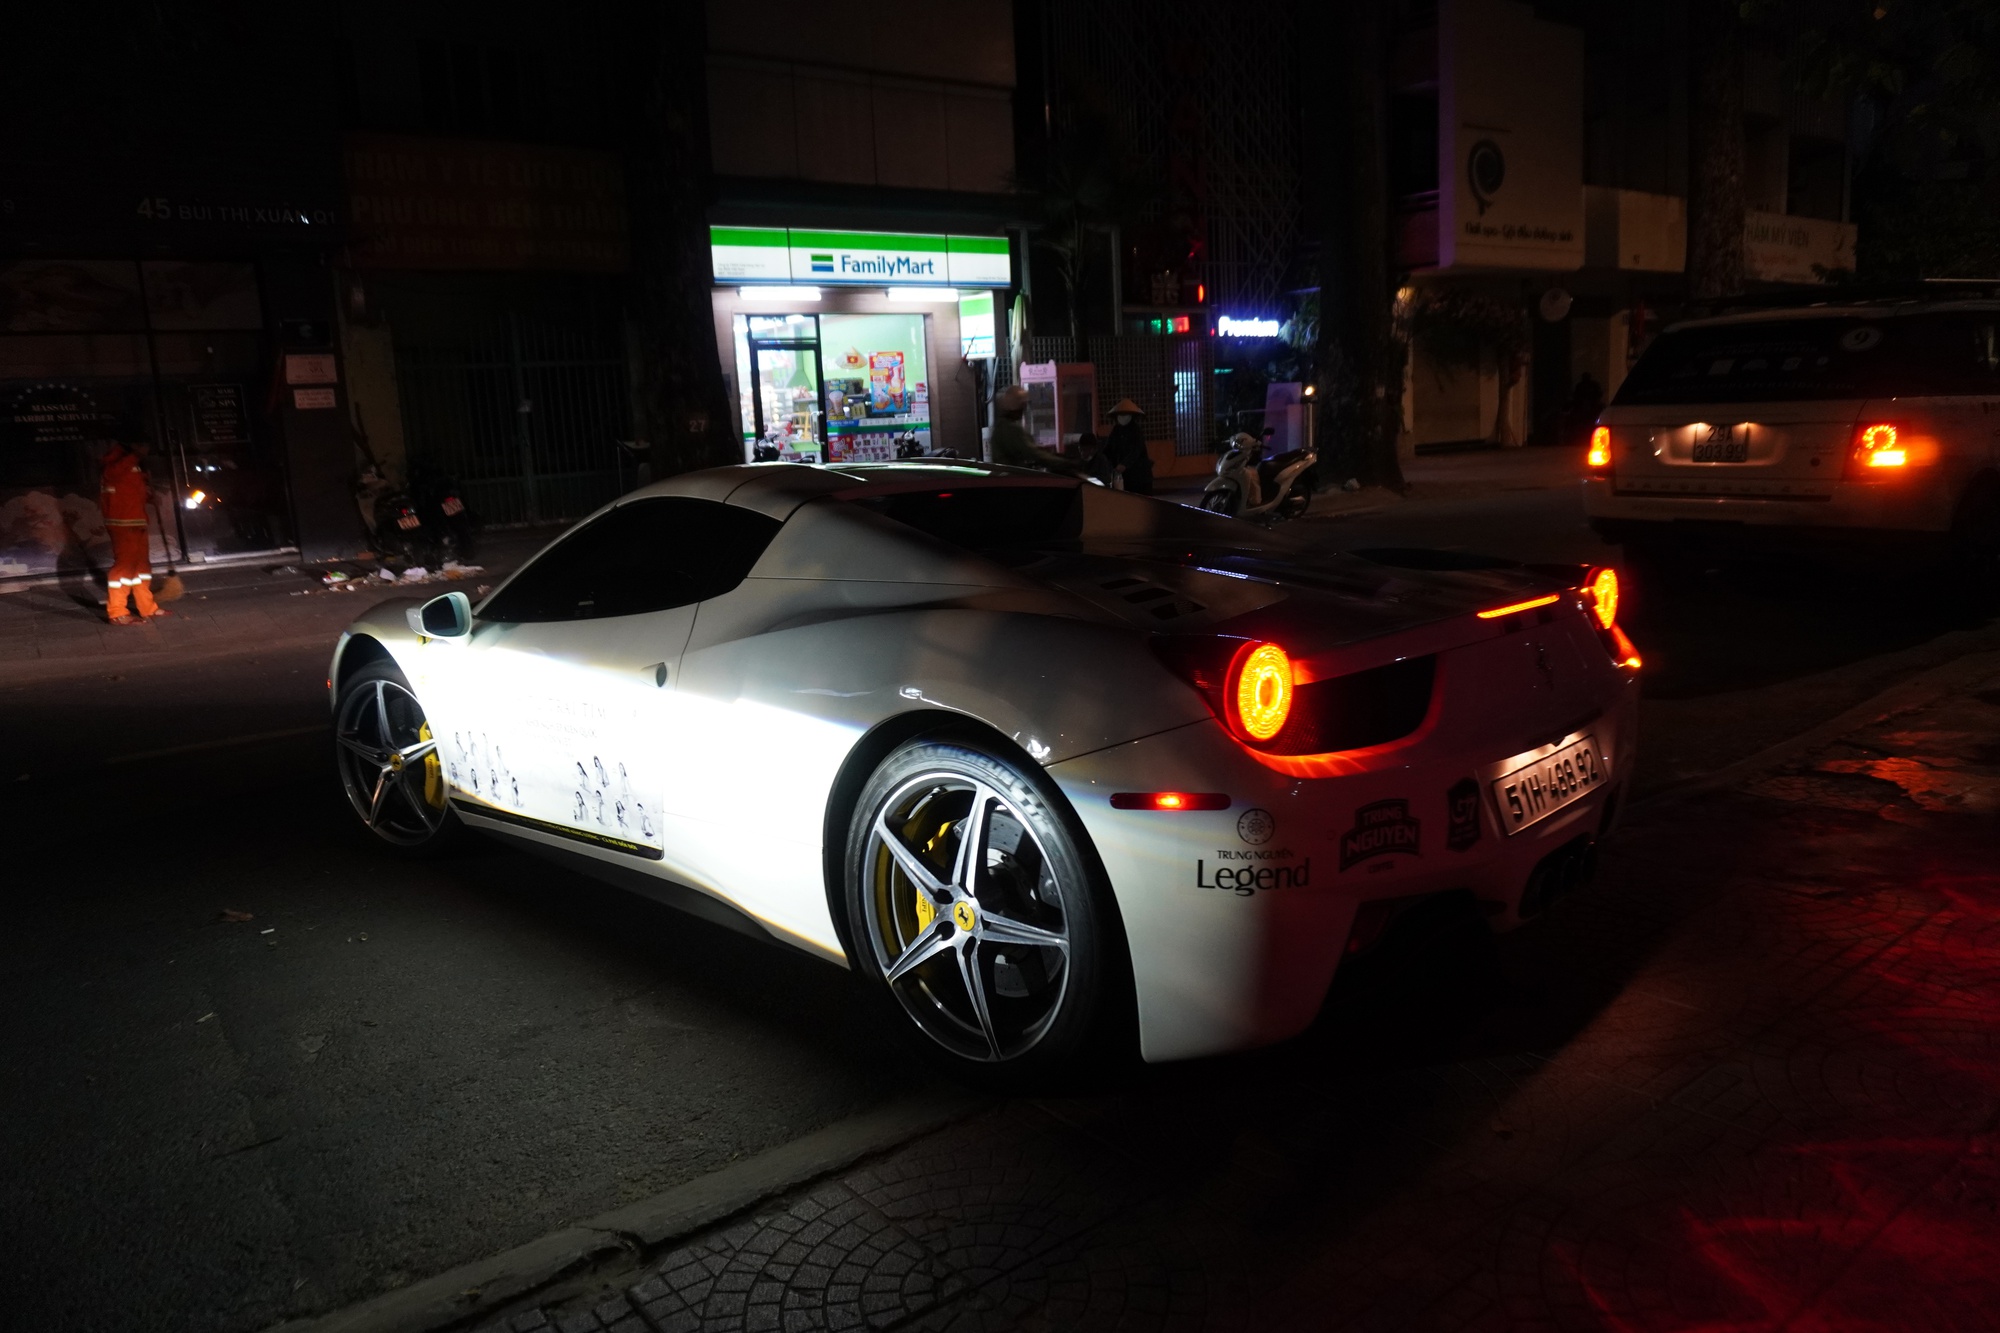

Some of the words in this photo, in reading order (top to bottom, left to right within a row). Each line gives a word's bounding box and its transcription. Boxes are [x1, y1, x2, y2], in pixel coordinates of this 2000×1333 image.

[136, 197, 172, 220] 45
[178, 197, 213, 220] BÙI
[219, 205, 250, 230] THỊ
[312, 209, 336, 225] Q1
[841, 254, 934, 276] FamilyMart
[1706, 425, 1734, 443] 29A
[1505, 748, 1598, 822] 51H-488.92
[1363, 806, 1403, 827] TRUNG
[1217, 850, 1252, 860] TRUNG
[1254, 848, 1295, 860] NGUYÊN
[1197, 857, 1310, 896] Legend
[1368, 860, 1395, 874] COFFEE
